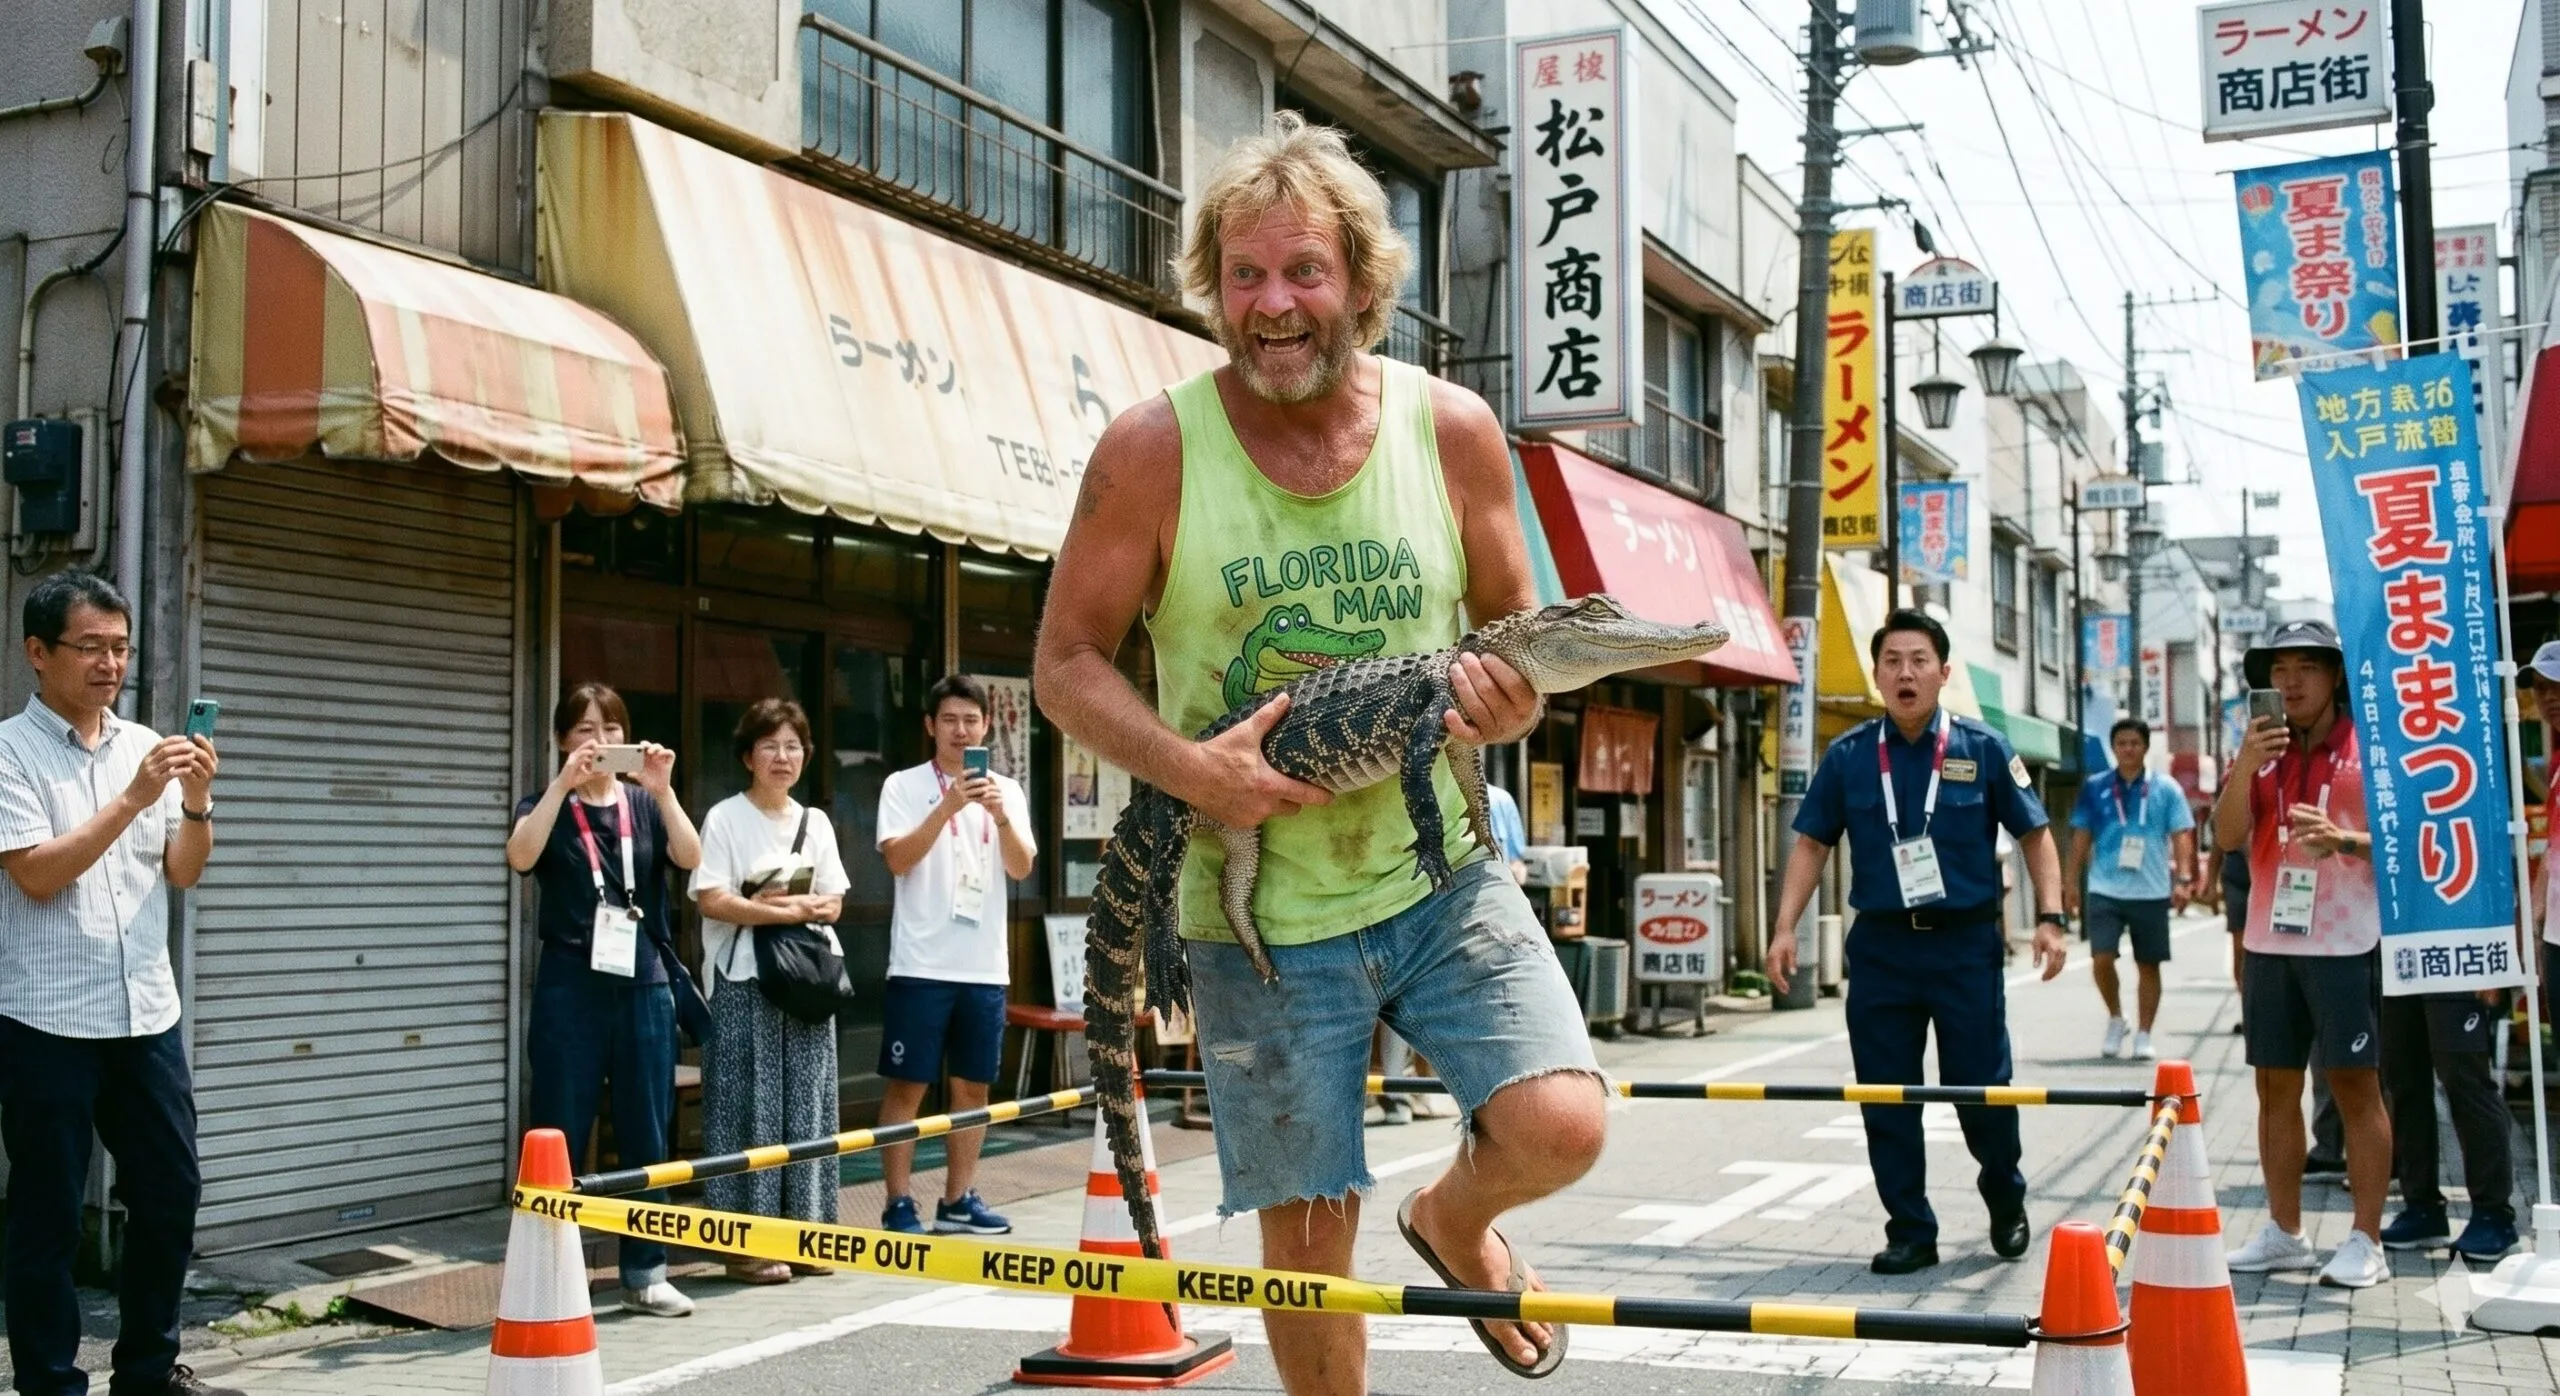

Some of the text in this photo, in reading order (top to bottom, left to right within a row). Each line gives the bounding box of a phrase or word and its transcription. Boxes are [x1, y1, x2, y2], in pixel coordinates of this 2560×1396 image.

[2215, 9, 2368, 56] ラーメン
[2218, 55, 2371, 115] 商店街
[1535, 99, 1606, 401] 松戸商店
[2282, 176, 2353, 339] 夏ま祭り
[1904, 280, 1982, 310] 商店街
[1826, 310, 1874, 503] ラーメン
[1221, 537, 1421, 608] FLORIDA
[1334, 584, 1423, 624] MAN
[2355, 466, 2477, 904] 夏ままつり
[1641, 888, 1708, 909] ラーメン
[2420, 941, 2508, 978] 商店街
[627, 1207, 691, 1239] KEEP
[699, 1217, 752, 1248] OUT
[799, 1230, 866, 1264] KEEP
[874, 1239, 931, 1272] OUT
[982, 1250, 1055, 1285] KEEP
[1064, 1260, 1124, 1293] OUT
[1177, 1270, 1254, 1303] KEEP
[1264, 1277, 1327, 1309] OUT
